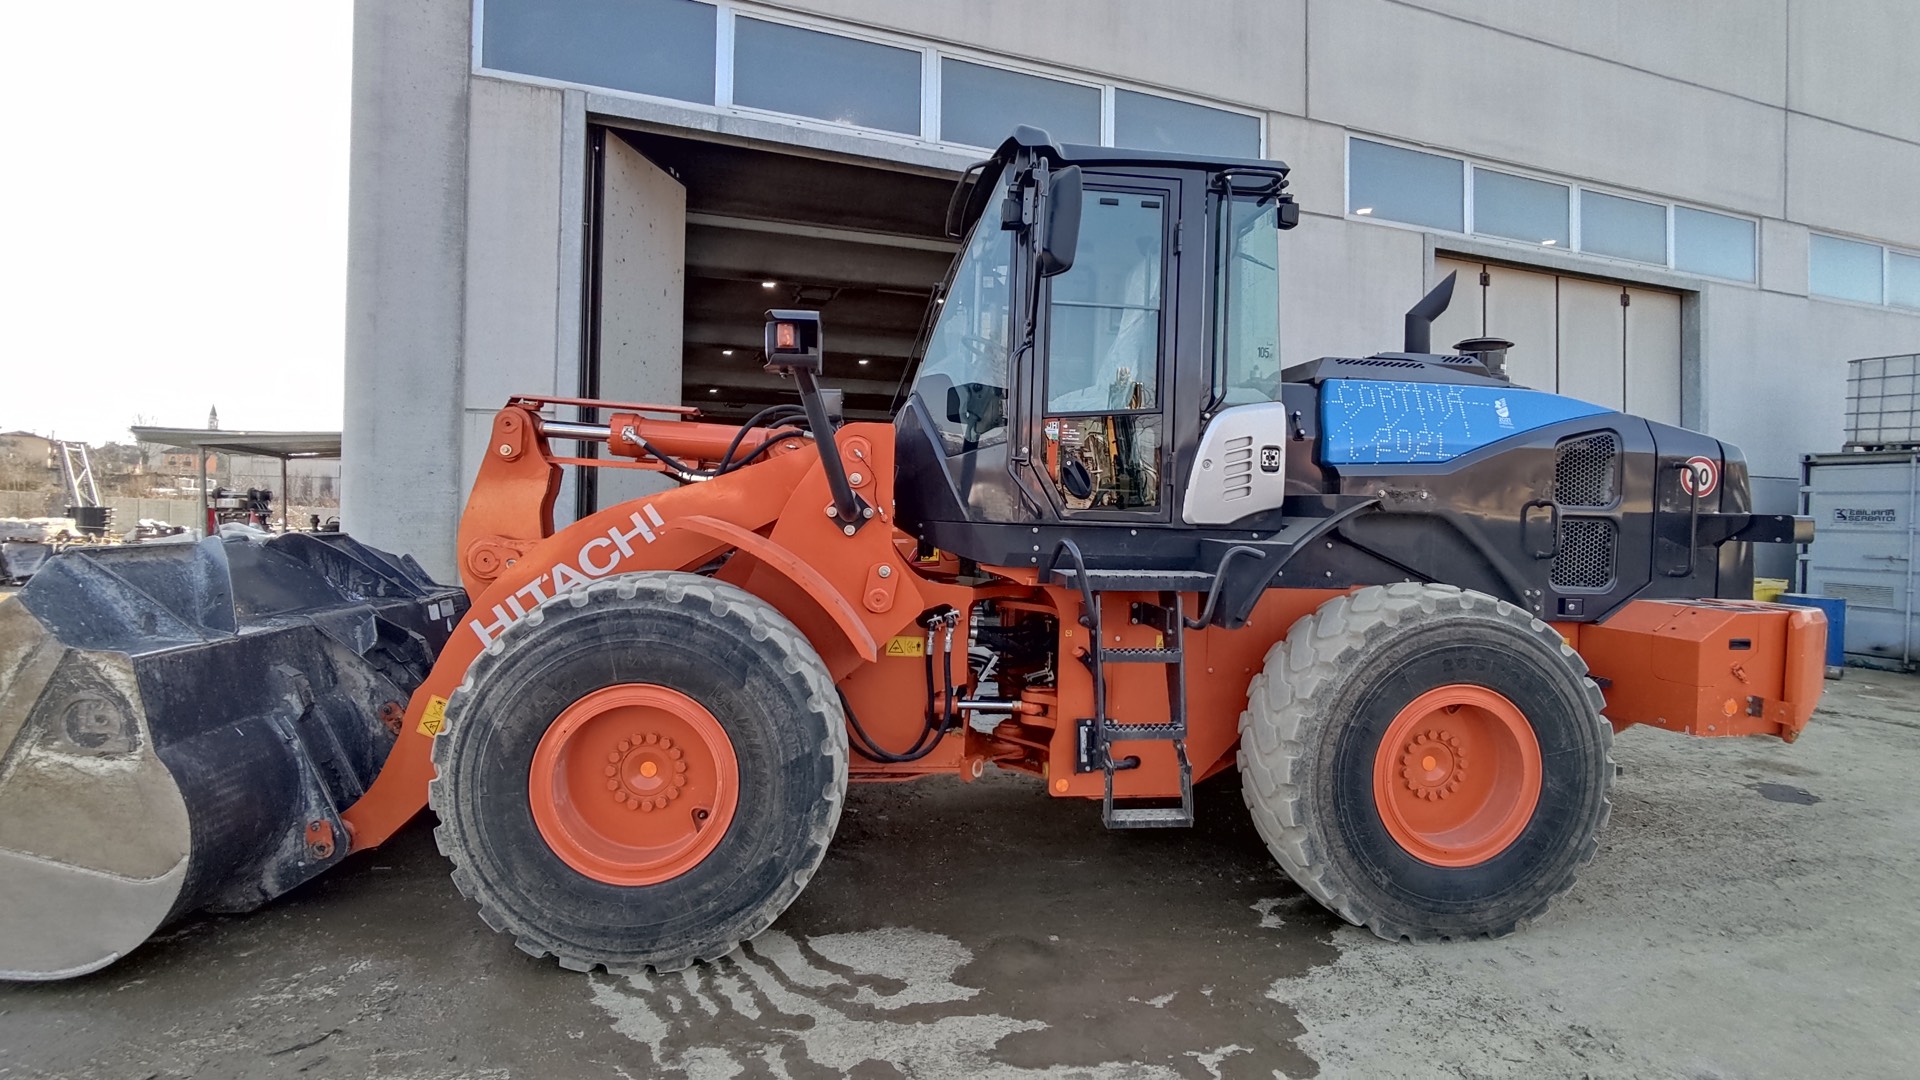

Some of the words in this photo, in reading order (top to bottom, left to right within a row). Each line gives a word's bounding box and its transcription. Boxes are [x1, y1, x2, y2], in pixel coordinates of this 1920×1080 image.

[1257, 346, 1270, 358] 105
[1336, 380, 1468, 416] CORTINA
[1373, 426, 1451, 459] 2021
[469, 503, 665, 650] HITACHI
